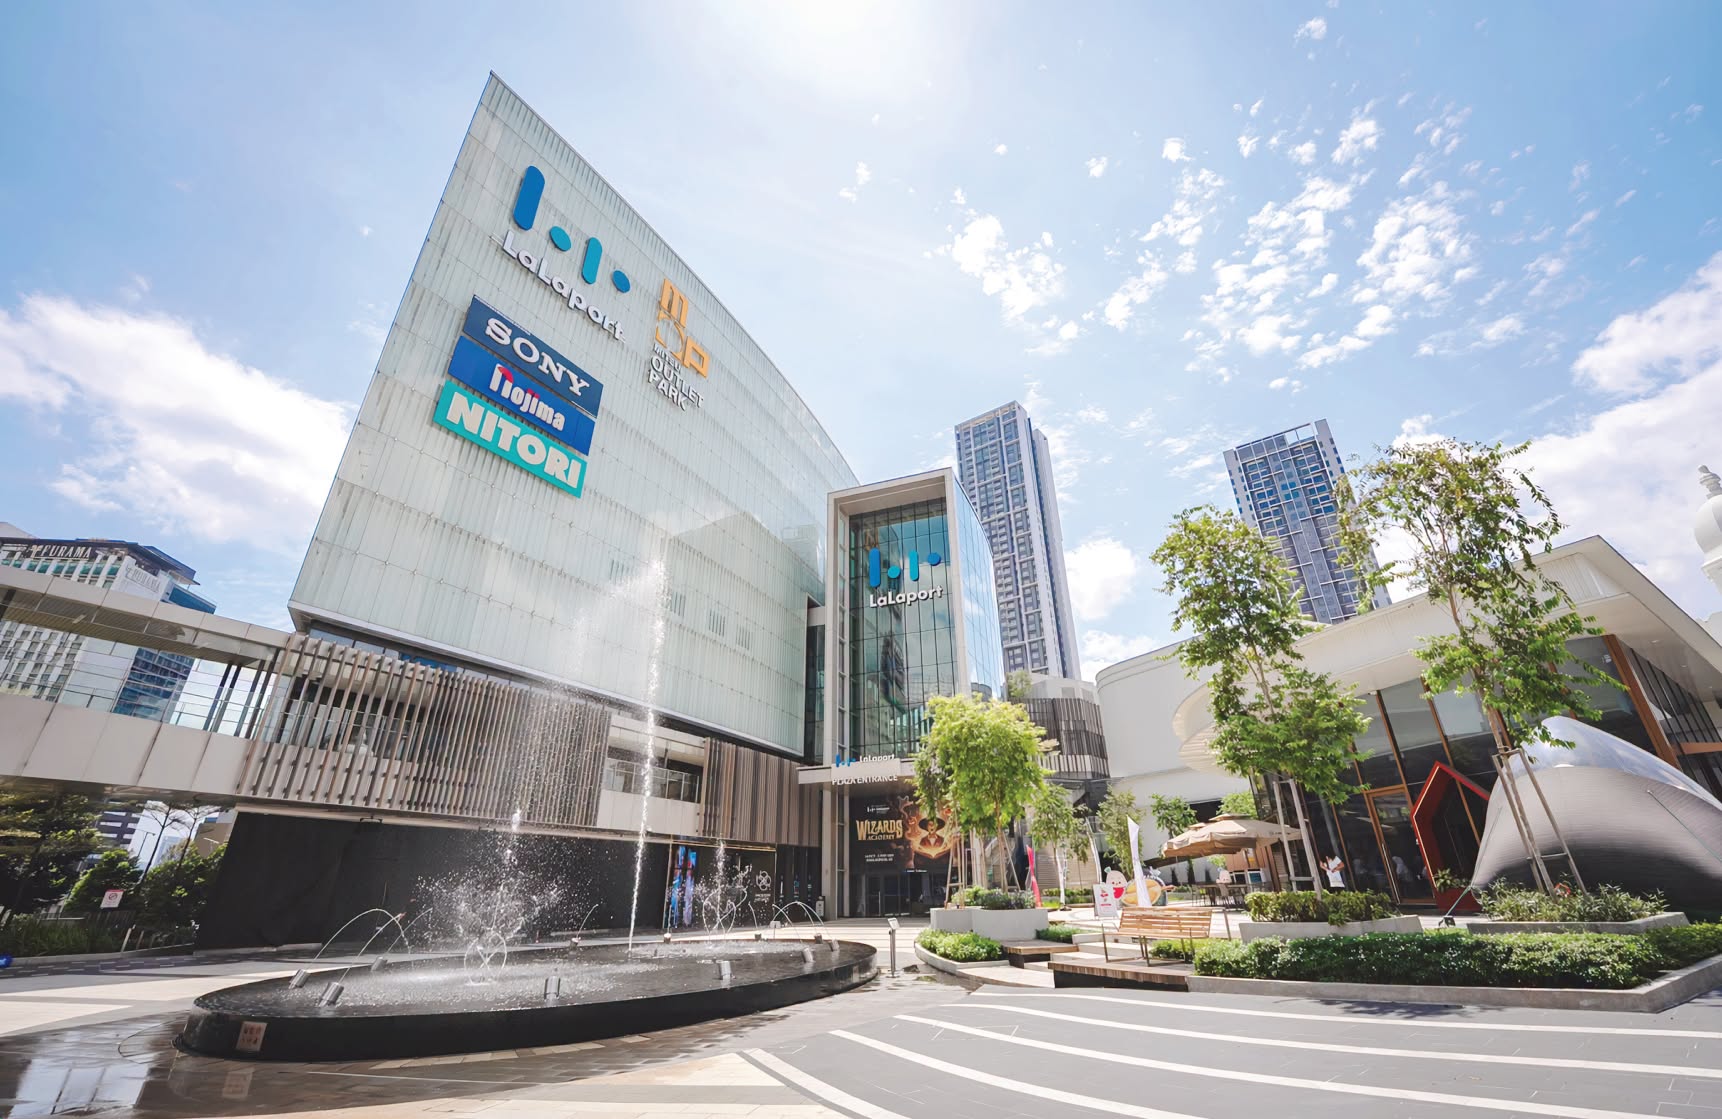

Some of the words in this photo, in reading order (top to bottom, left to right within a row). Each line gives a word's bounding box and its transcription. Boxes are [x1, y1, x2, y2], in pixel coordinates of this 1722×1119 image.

[502, 230, 626, 341] LaLaport
[484, 317, 590, 397] SONY
[647, 369, 686, 411] PARK
[651, 355, 704, 408] OUTLET
[446, 391, 582, 489] NITORI
[40, 544, 92, 558] FURAMA
[869, 585, 943, 608] LaLaport
[831, 776, 856, 785] PLAZA
[857, 775, 898, 784] ENTRANCE
[856, 820, 903, 840] WIZARDS
